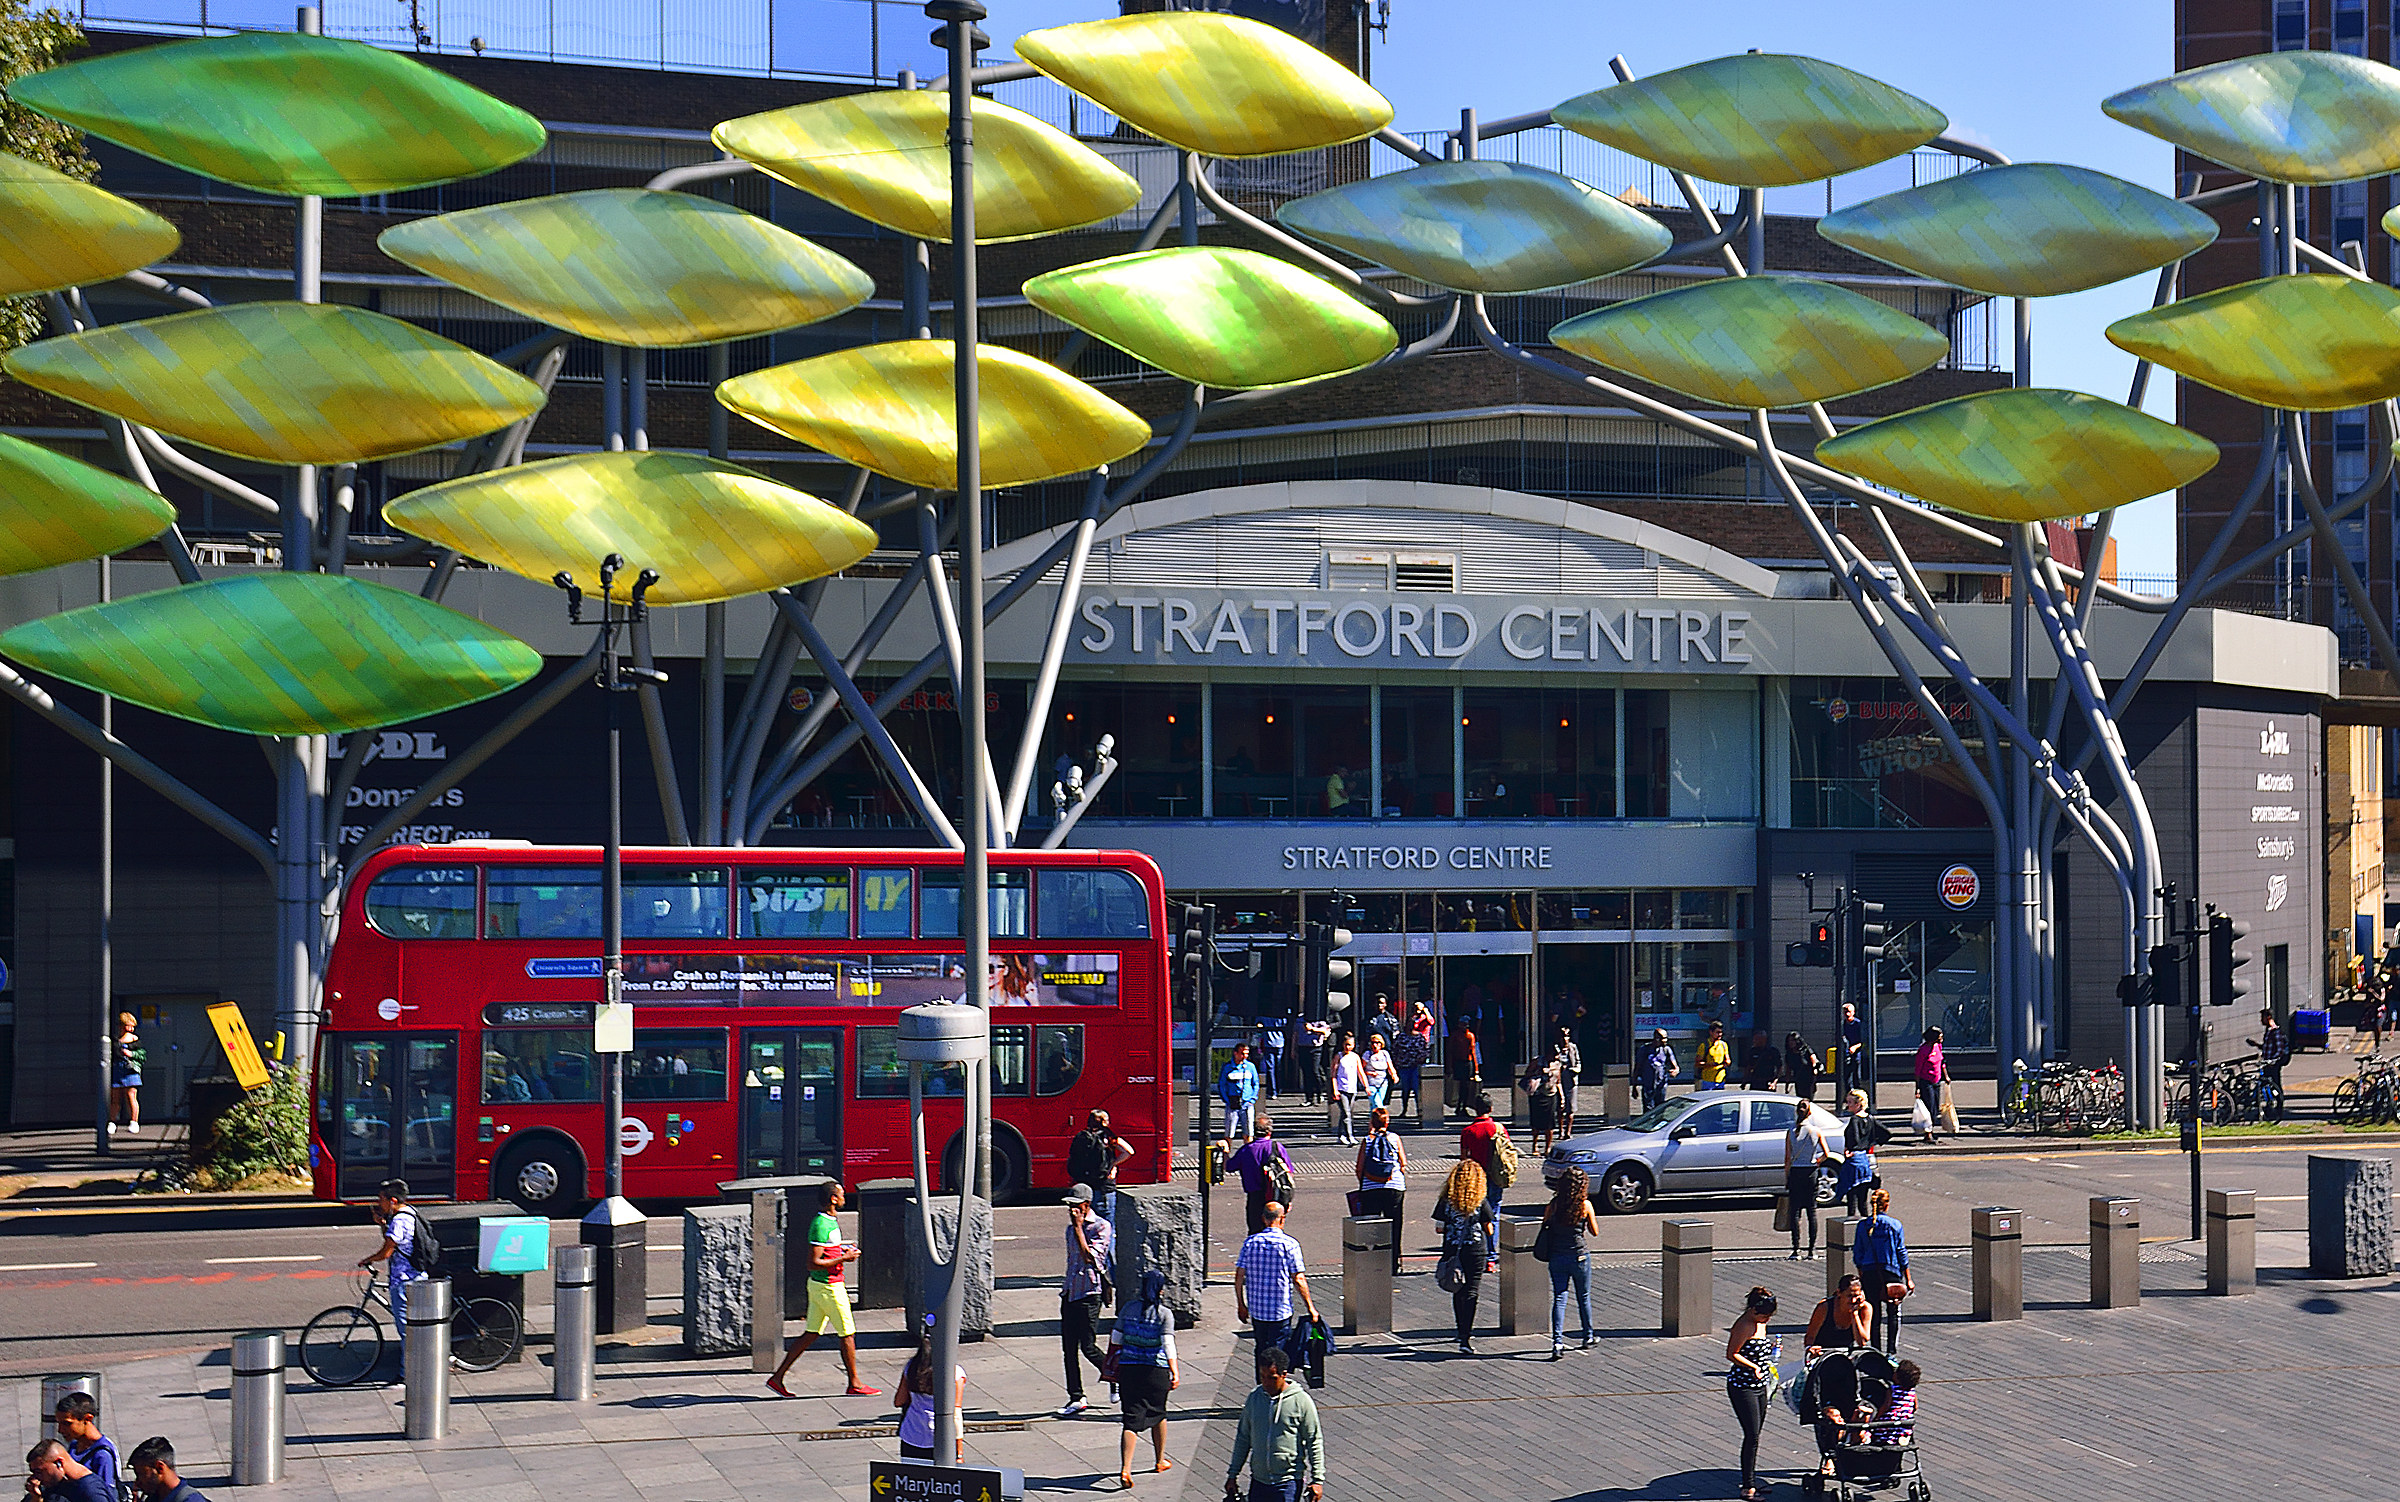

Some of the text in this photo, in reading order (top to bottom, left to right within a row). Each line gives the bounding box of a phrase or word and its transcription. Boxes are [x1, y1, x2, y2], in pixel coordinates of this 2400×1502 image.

[1081, 595, 1753, 663] STRATFORD CENTRE
[2256, 773, 2294, 792] McDonald's
[2257, 836, 2294, 861] Sainsbury's
[1283, 846, 1552, 869] STRATFORD CENTRE
[1944, 876, 1976, 885] BURGER
[1943, 884, 1976, 896] KING
[673, 970, 702, 980] Cash
[705, 971, 718, 980] to
[720, 970, 770, 980] Romania
[772, 971, 783, 980] in
[622, 981, 651, 990] From
[691, 981, 736, 990] transfer
[764, 981, 780, 990] Tot
[782, 981, 803, 990] mai
[503, 1007, 530, 1021] 425
[1635, 1016, 1657, 1025] FREE
[894, 1475, 962, 1496] Maryland
